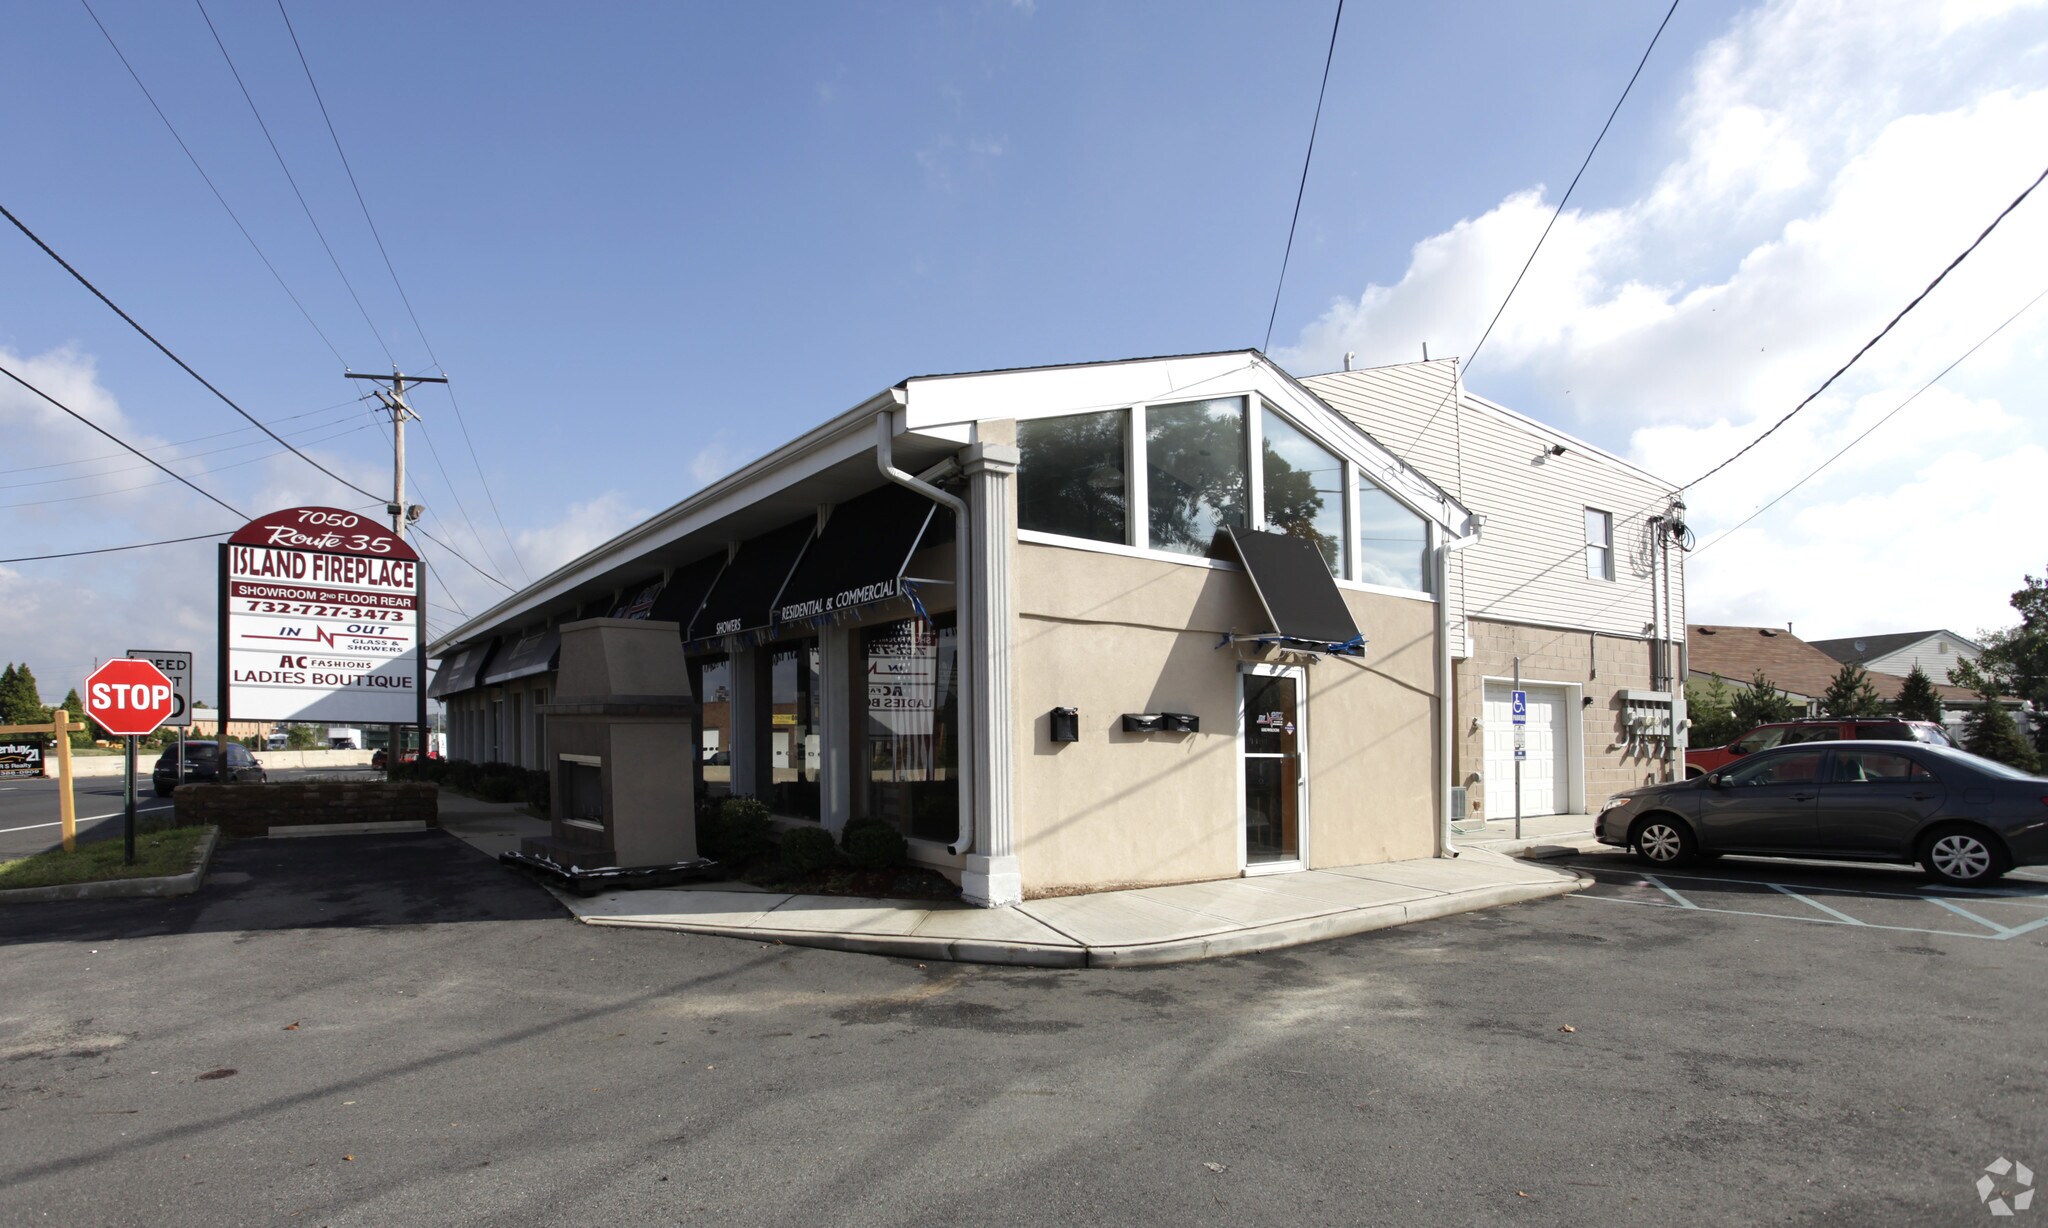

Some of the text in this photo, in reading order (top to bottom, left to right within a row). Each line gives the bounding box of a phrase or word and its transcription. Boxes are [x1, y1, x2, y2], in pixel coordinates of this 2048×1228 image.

[298, 510, 359, 528] 7050
[264, 525, 392, 553] Route 35
[233, 546, 414, 588] ISLAND FIREPLACE
[239, 585, 317, 600] SHOWROOM
[338, 593, 377, 605] FLOOR
[380, 596, 412, 607] REAR
[781, 579, 895, 620] RESIDENTIAL & COMMERCIAL
[246, 600, 404, 622] 732-727-3473
[278, 626, 302, 637] IN
[346, 624, 390, 636] OUT
[715, 618, 741, 635] SHOWERS
[347, 645, 403, 653] SHOWERS
[352, 639, 400, 647] GLASS &
[279, 655, 372, 669] AC FASHIONS
[234, 670, 413, 688] LADIES BOUTIQUE
[92, 682, 170, 710] STOP
[26, 748, 40, 761] 21
